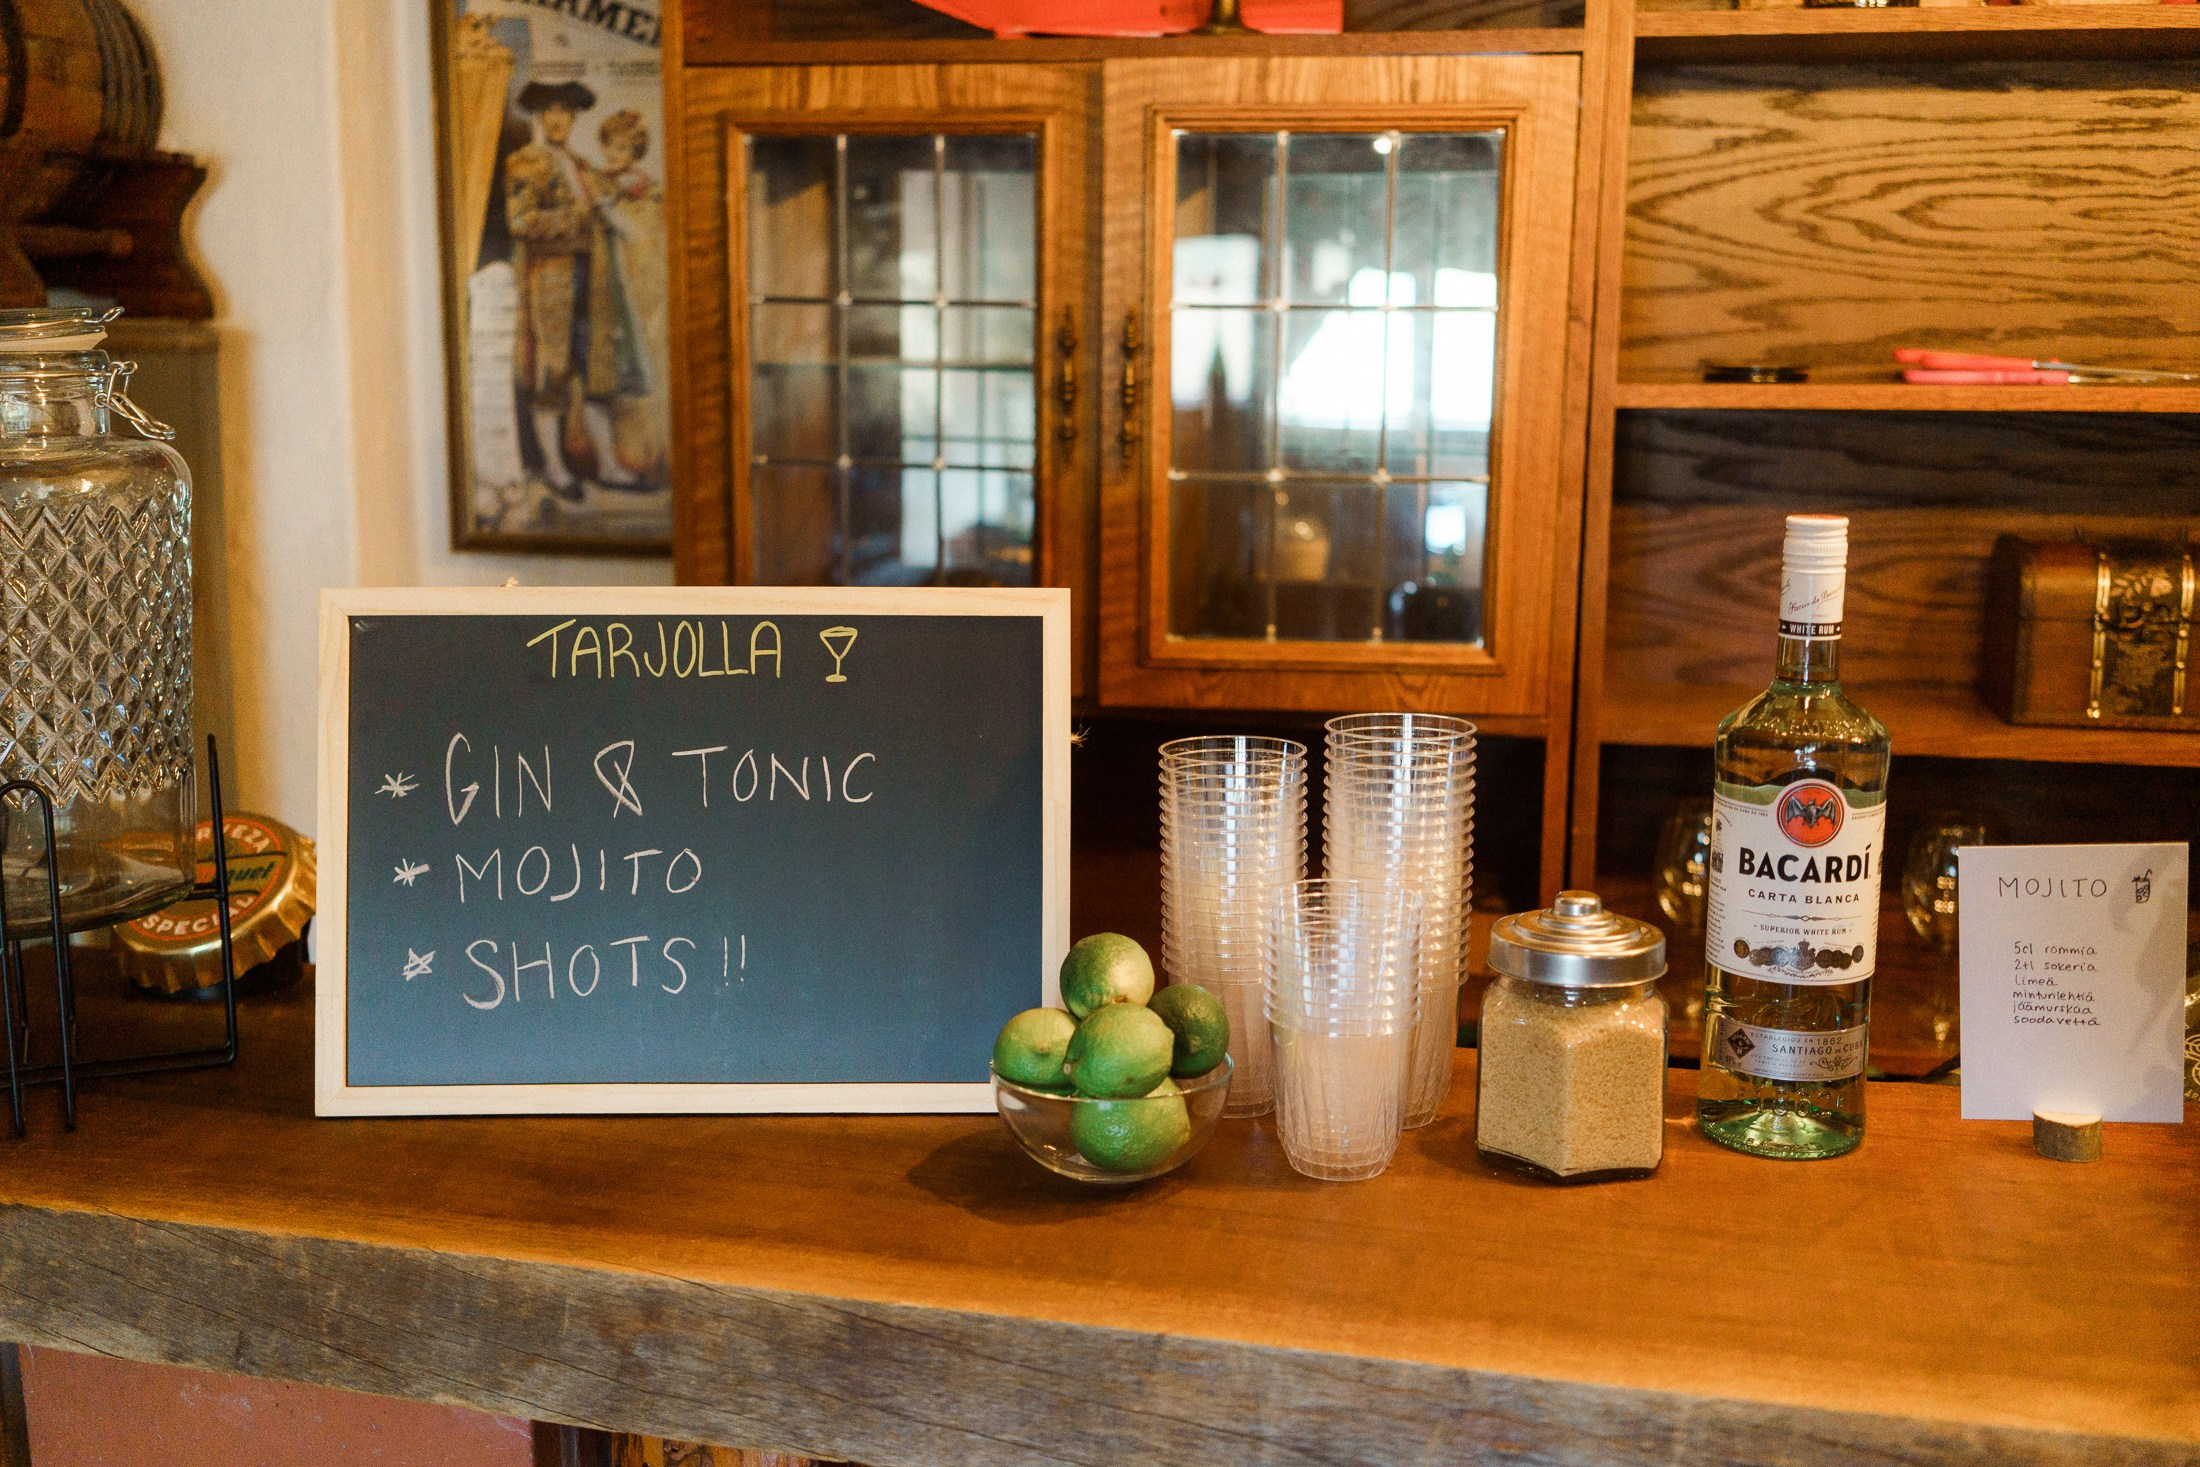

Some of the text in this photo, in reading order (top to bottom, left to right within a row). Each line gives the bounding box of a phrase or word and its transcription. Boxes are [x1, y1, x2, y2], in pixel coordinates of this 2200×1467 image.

[1790, 623, 1835, 635] WHITE RUM
[527, 619, 782, 679] TARJOLLA
[444, 732, 877, 826] GIN & TONIC
[1739, 843, 1871, 882] BACARDÍ
[455, 845, 702, 903] MOJITO
[1998, 876, 2108, 899] MOJITO
[1748, 888, 1861, 905] CARTA BLANCA
[1760, 924, 1800, 935] SUPERIOR
[1803, 928, 1829, 936] WHITE
[2013, 940, 2099, 956] 5cl rommia
[2044, 961, 2099, 972] sokeria
[2012, 990, 2096, 1002] mintunlehtiä
[1772, 1044, 1833, 1055] SANTIAGO
[1843, 1040, 1863, 1052] CUBA
[1817, 1036, 1843, 1046] 1862
